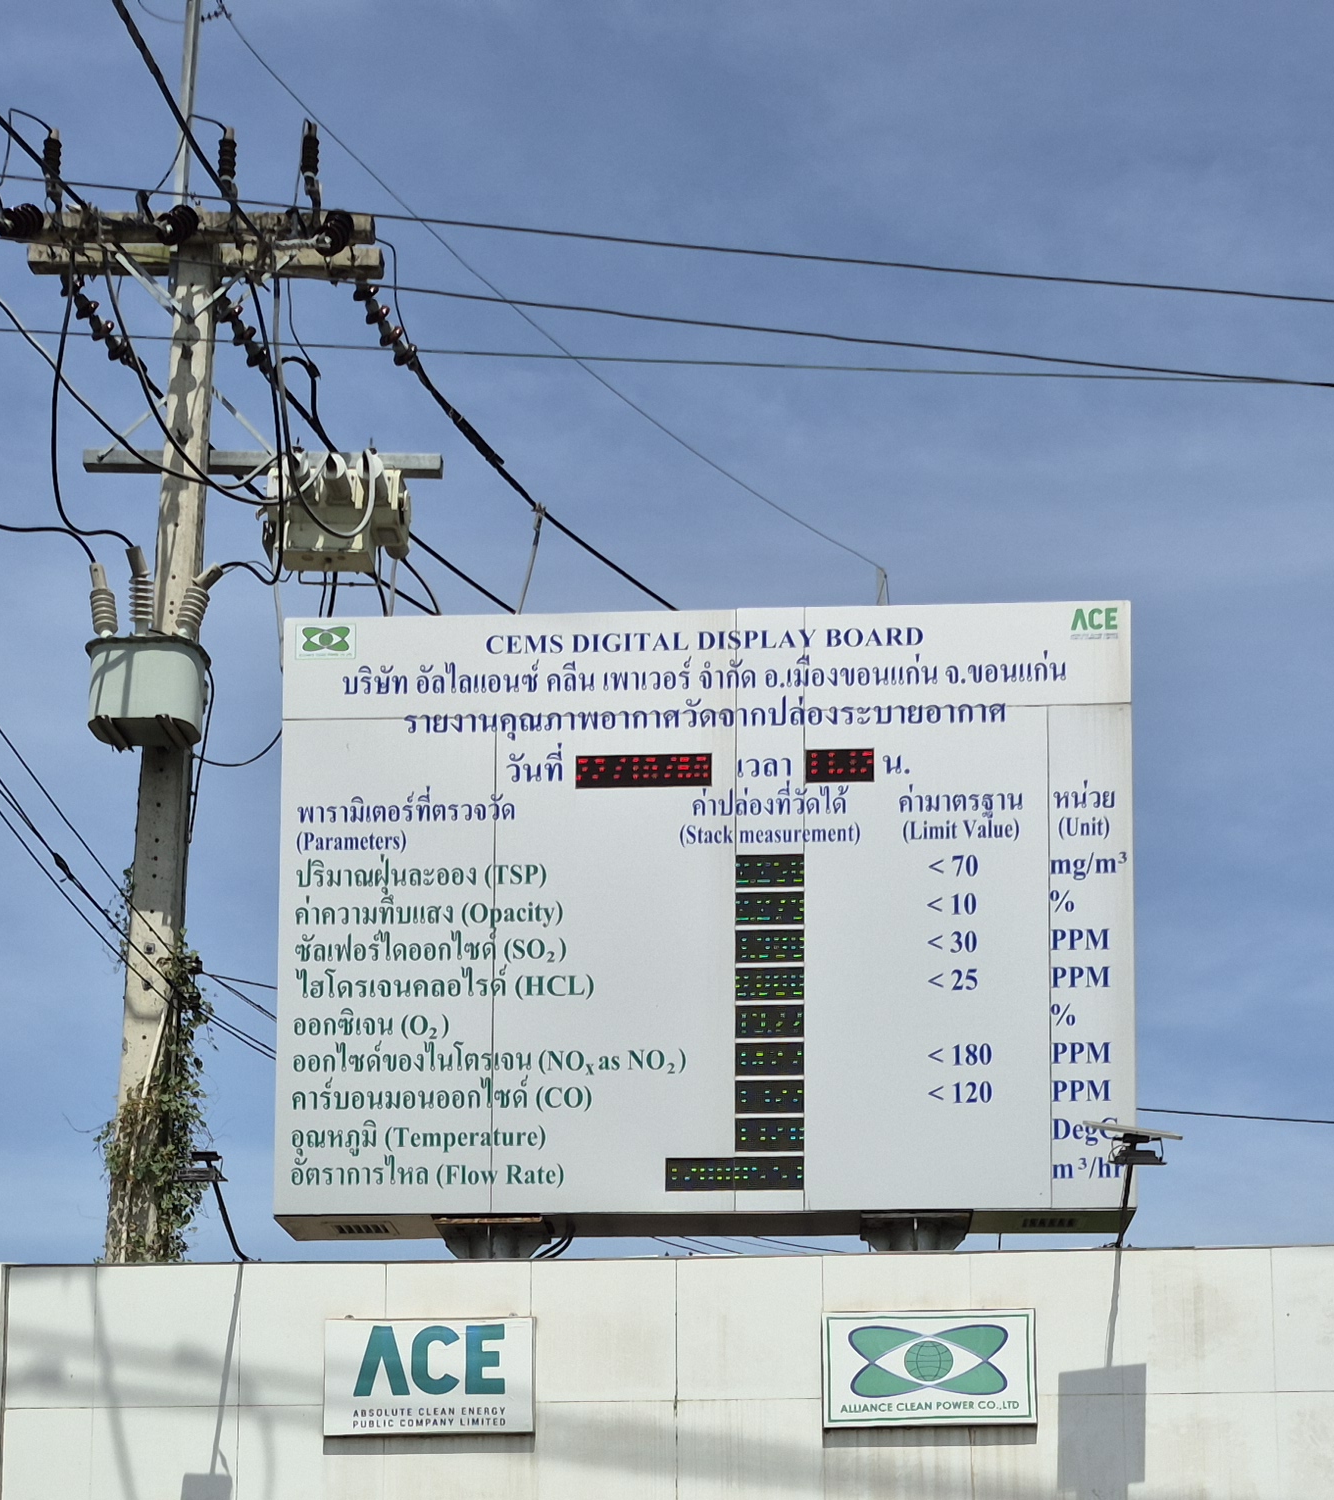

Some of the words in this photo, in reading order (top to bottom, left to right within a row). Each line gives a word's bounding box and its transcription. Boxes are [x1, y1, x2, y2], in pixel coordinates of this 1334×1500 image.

[1071, 607, 1118, 631] ACE
[485, 633, 564, 655] CEMS
[572, 631, 689, 654] DIGITAL
[698, 629, 817, 651] DISPLAY
[825, 626, 924, 648] BOARD
[342, 665, 409, 696] บริษัท
[416, 659, 540, 695] อัลไลแอนซ์
[547, 663, 596, 693] คลีน
[603, 656, 691, 692] เพาเวอร์
[698, 659, 756, 690] จำกัด
[764, 653, 939, 689] อ.เมืองขอนแก่น
[944, 649, 1067, 684] จ.ขอนแก่น
[506, 743, 564, 784] วันที่
[736, 754, 793, 779] เวลา
[882, 753, 911, 776] น.
[297, 786, 516, 824] พารามิเตอร์ที่ตรวจวัด
[692, 780, 850, 817] ค่าปล่องที่วัดได้
[898, 783, 1024, 818] ค่ามาตรฐาน
[1053, 780, 1116, 809] หน่วย
[679, 823, 733, 848] (Stack
[739, 821, 862, 846] measurement)
[902, 819, 958, 844] (Limit
[963, 817, 1021, 842] Value)
[1058, 815, 1111, 840] (Unit)
[296, 830, 407, 853] (Parameters)
[295, 853, 478, 896] ปริมาณฝุ่นละออง
[484, 863, 548, 890] (TSP)
[951, 854, 979, 877] 70
[295, 894, 454, 926] ค่าความทึบแสง
[461, 900, 564, 928] (Opacity)
[951, 892, 978, 915] 10
[1050, 889, 1075, 913] %
[295, 927, 497, 963] ซัลเฟอร์ไดออกไซด์
[950, 930, 978, 954] 30
[1051, 928, 1110, 951] PPM
[295, 963, 507, 999] ไฮโดรเจนคลอไรด์
[514, 973, 595, 1000] (HCL)
[950, 968, 979, 992] 25
[1051, 966, 1111, 989] PPM
[293, 1008, 394, 1037] ออกซิเจน
[1051, 1003, 1076, 1027] %
[293, 1040, 532, 1073] ออกไซด์ของไนโตรเจน
[951, 1042, 993, 1067] 180
[1052, 1041, 1112, 1065] PPM
[292, 1075, 529, 1111] คาร์บอนมอนออกไซด์
[535, 1086, 593, 1112] (CO)
[951, 1080, 994, 1104] 120
[1052, 1079, 1112, 1102] PPM
[291, 1119, 378, 1156] อุณหภูมิ
[384, 1125, 547, 1153] (Temperature)
[291, 1154, 430, 1186] อัตราการไหล
[436, 1163, 499, 1189] (Flow
[505, 1161, 566, 1188] Rate)
[352, 1323, 506, 1398] ACE
[352, 1407, 413, 1418] ABSOLUTE
[418, 1407, 456, 1416] CLEAN
[461, 1406, 506, 1416] ENERGY
[840, 1402, 894, 1414] ALLIANCE
[896, 1401, 933, 1412] CLEAN
[936, 1400, 975, 1411] POWER
[352, 1418, 395, 1429] PUBLIC
[399, 1417, 455, 1428] COMPANY
[459, 1416, 506, 1427] LIMITED
